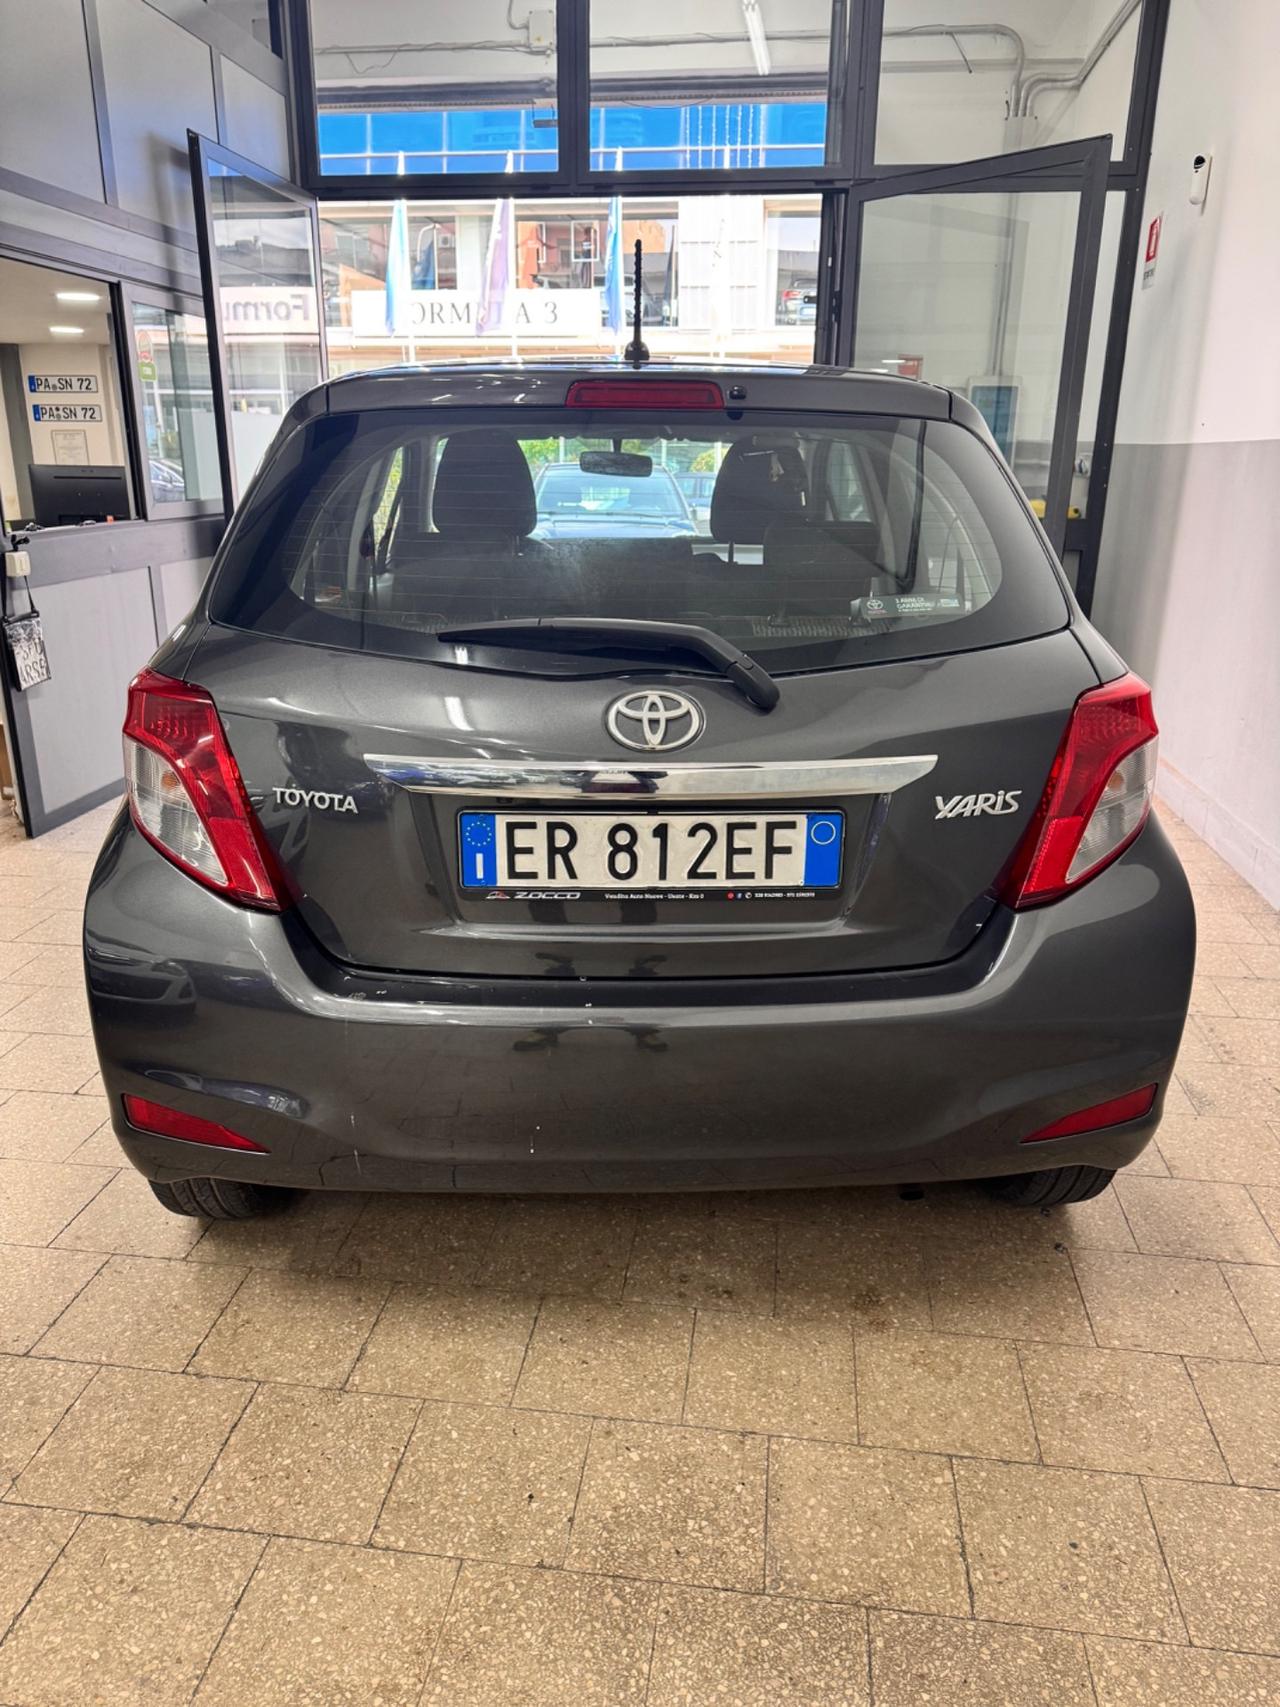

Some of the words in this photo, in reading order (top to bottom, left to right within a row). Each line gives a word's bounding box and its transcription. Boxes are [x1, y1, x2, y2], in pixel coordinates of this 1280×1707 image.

[544, 301, 559, 324] 3
[36, 378, 51, 391] PA
[58, 377, 73, 391] SN
[77, 378, 92, 391] 72
[41, 407, 56, 420] PA
[62, 407, 78, 420] SN
[81, 408, 97, 421] 72
[272, 787, 359, 813] TOYOTA
[505, 821, 578, 880] ER
[606, 820, 798, 881] 812EF
[514, 891, 581, 900] ZOCCO
